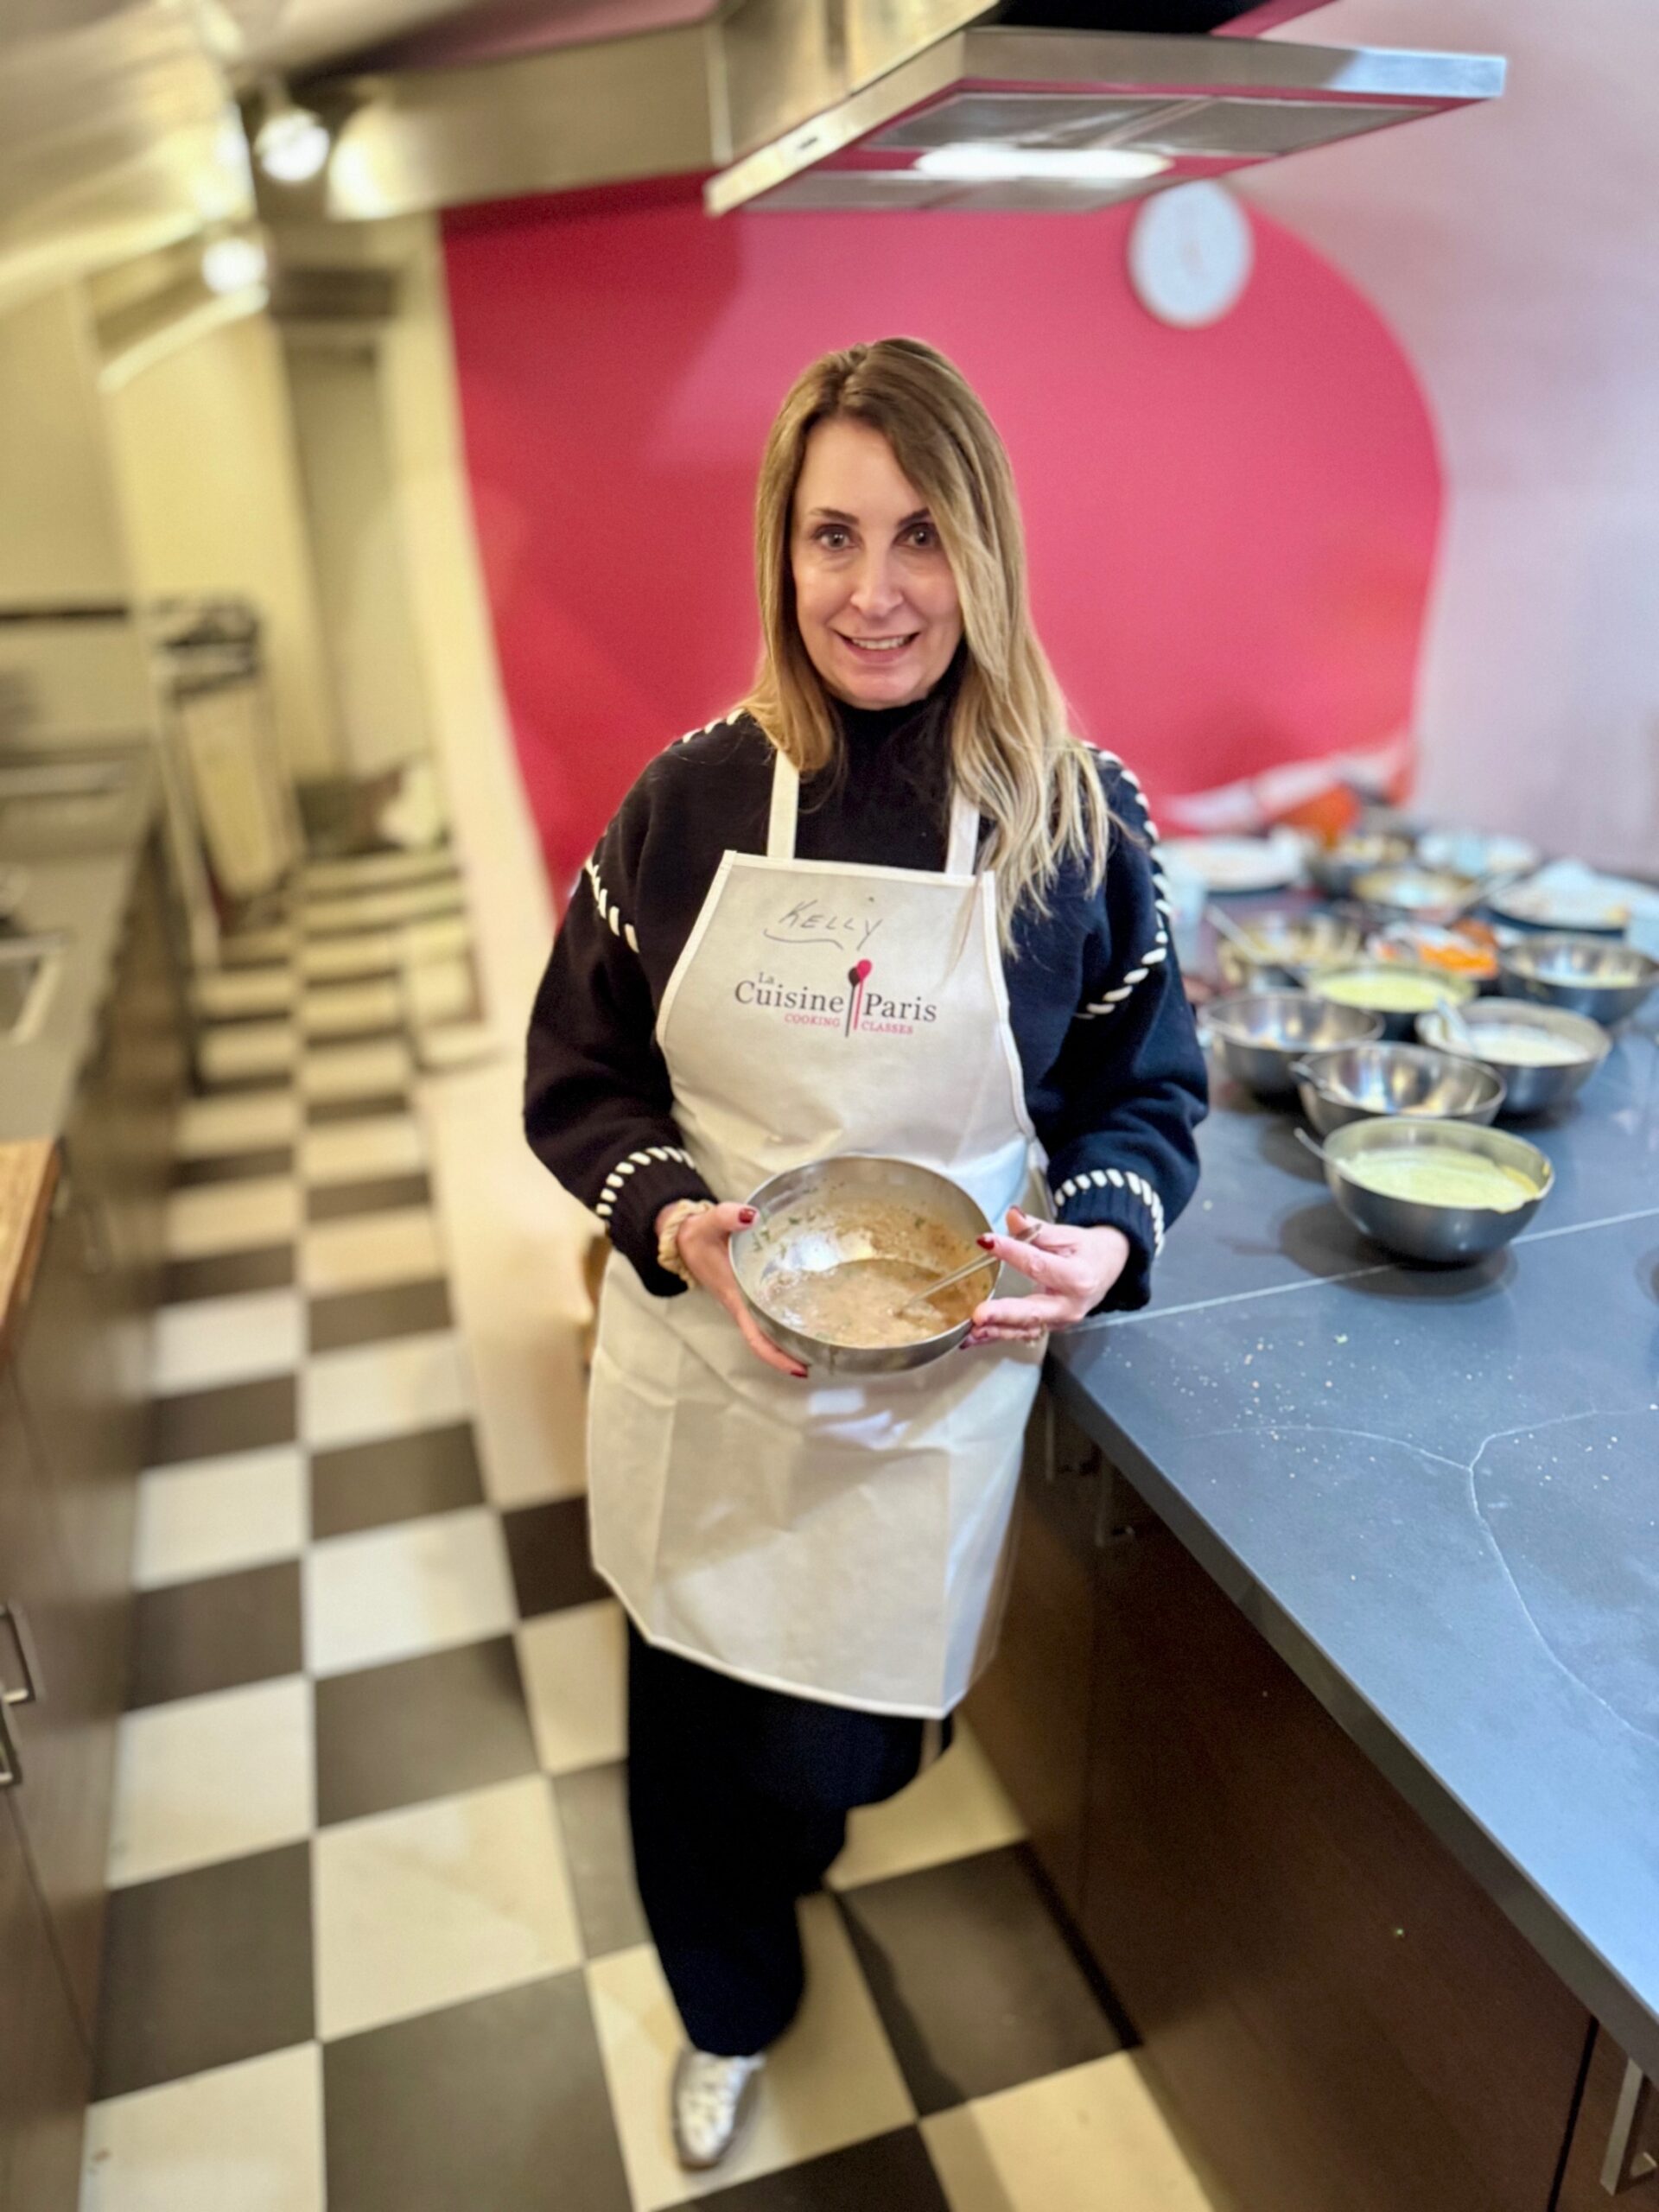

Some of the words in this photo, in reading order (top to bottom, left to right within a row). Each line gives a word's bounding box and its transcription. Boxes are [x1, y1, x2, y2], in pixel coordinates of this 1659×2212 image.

[779, 899, 883, 950] KELLY
[758, 971, 775, 985] La
[734, 980, 844, 1014] Cuisine
[861, 992, 938, 1022] Paris
[784, 1013, 841, 1028] COOKING
[861, 1021, 914, 1035] CLASSES
